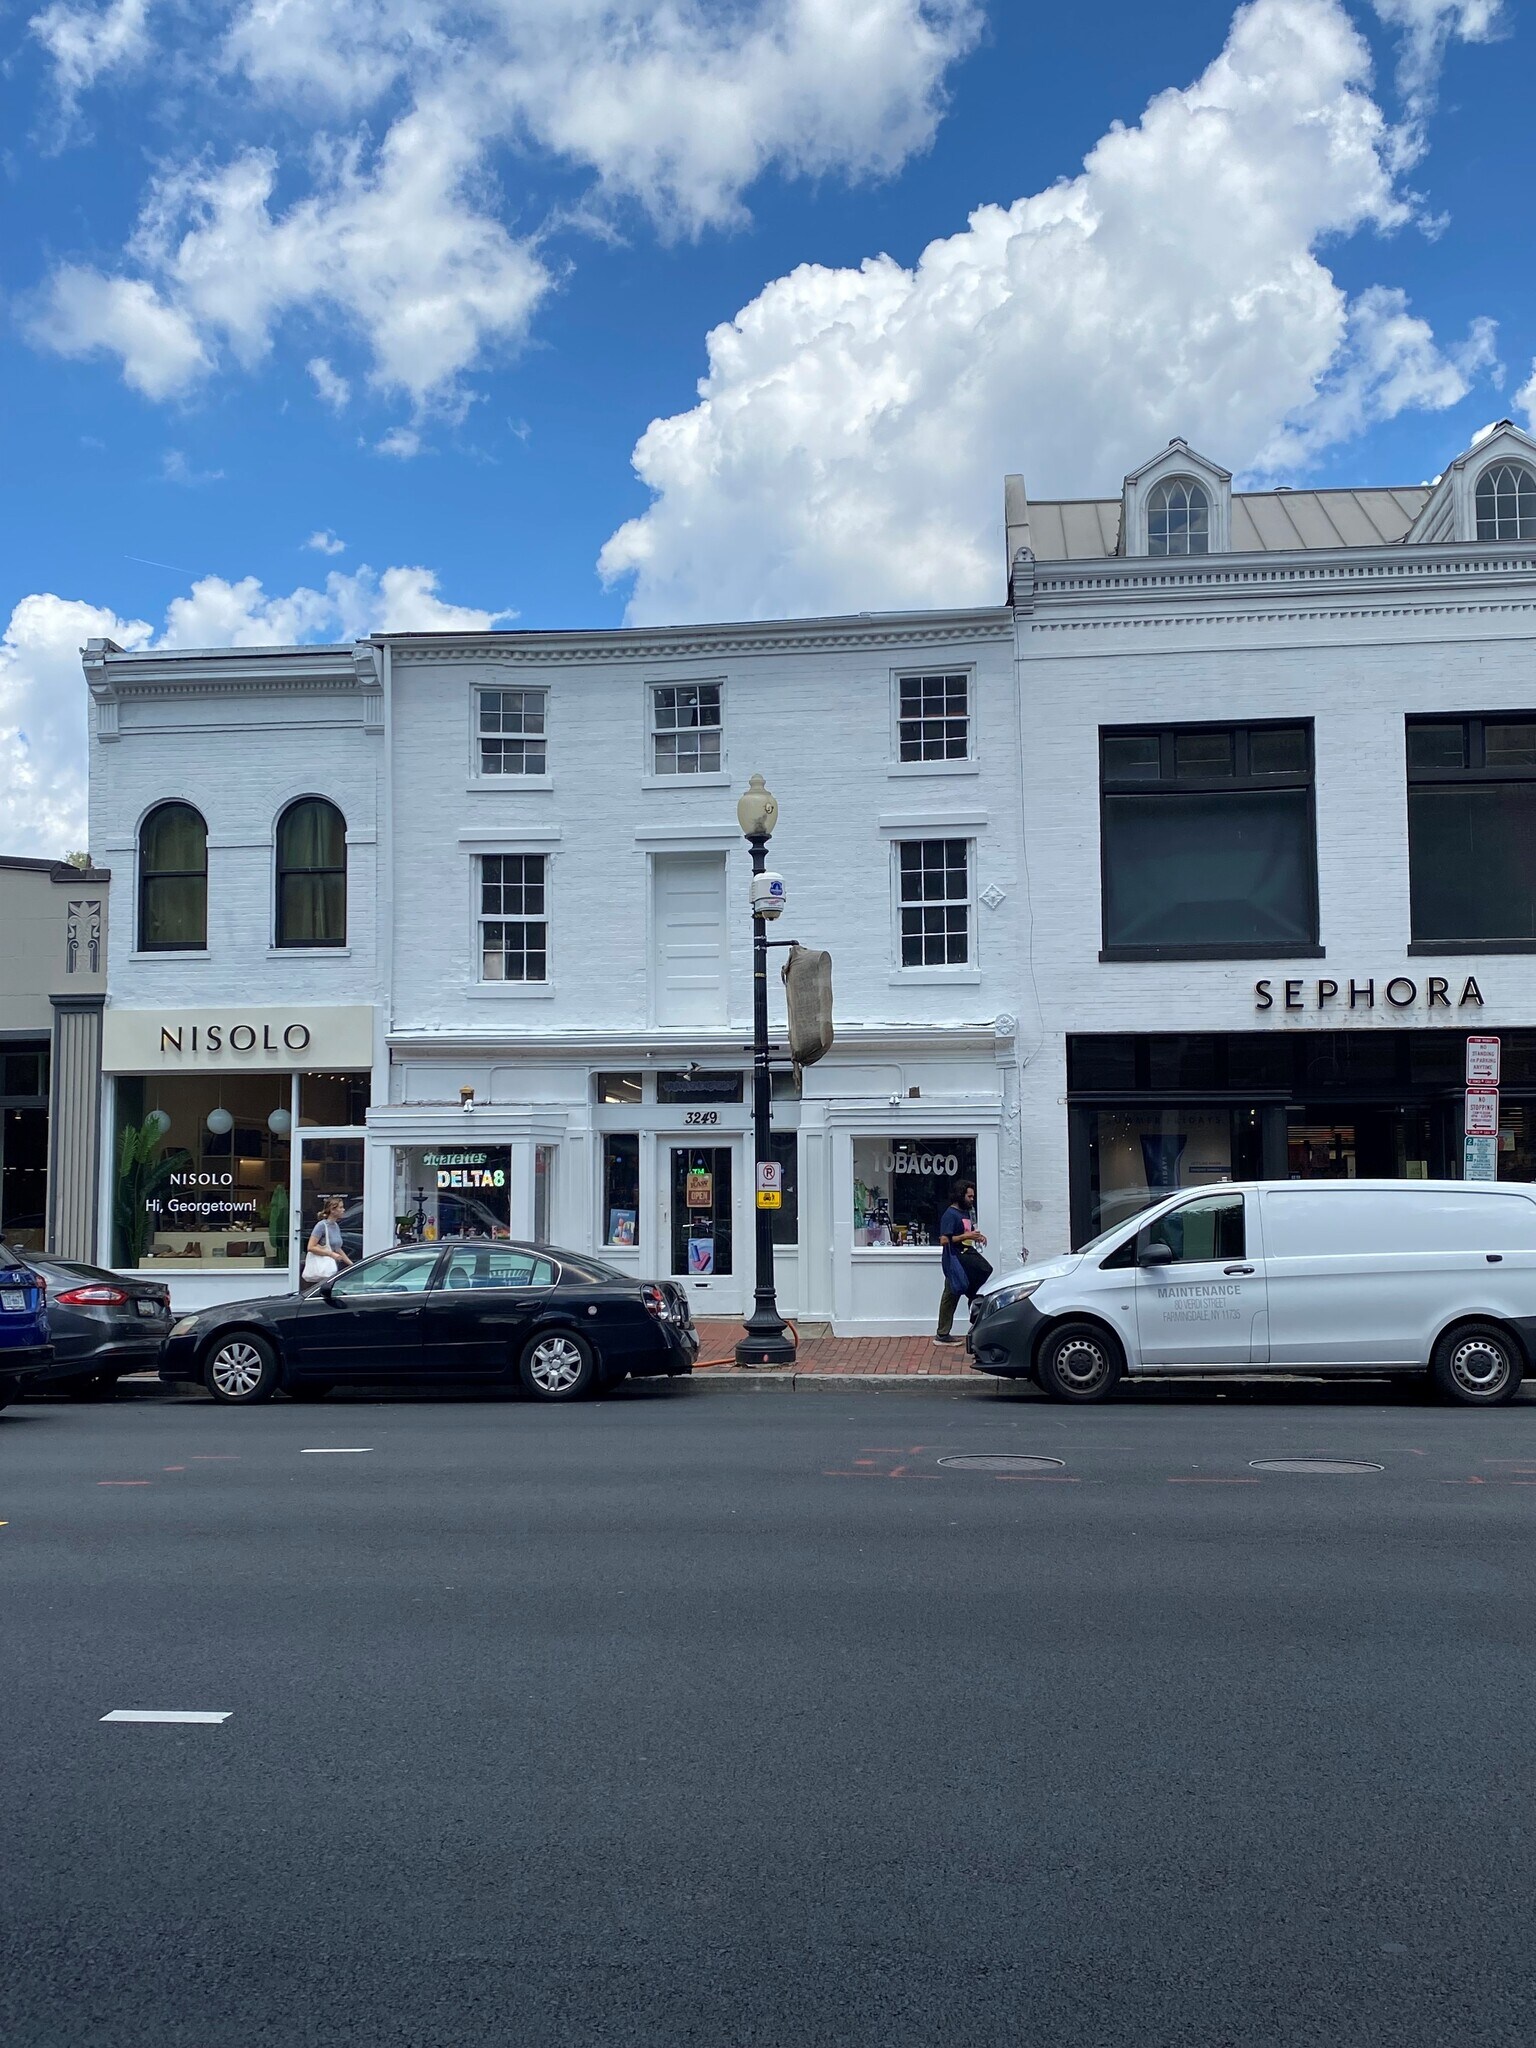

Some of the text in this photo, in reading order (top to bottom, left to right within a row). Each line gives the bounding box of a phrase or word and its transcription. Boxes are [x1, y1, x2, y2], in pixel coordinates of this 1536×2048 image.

[1254, 976, 1485, 1010] SEPHORA
[160, 1023, 311, 1052] NISOLO
[684, 1111, 718, 1125] 3249
[422, 1150, 487, 1168] Cigarettes
[873, 1151, 958, 1176] TOBACCO
[170, 1173, 233, 1185] NISOLO
[690, 1191, 708, 1200] OPEN
[145, 1198, 257, 1216] Hi, Georgetown!
[1157, 1285, 1242, 1298] MAINTENANCE
[1203, 1297, 1226, 1309] STREET
[1211, 1310, 1220, 1321] NY
